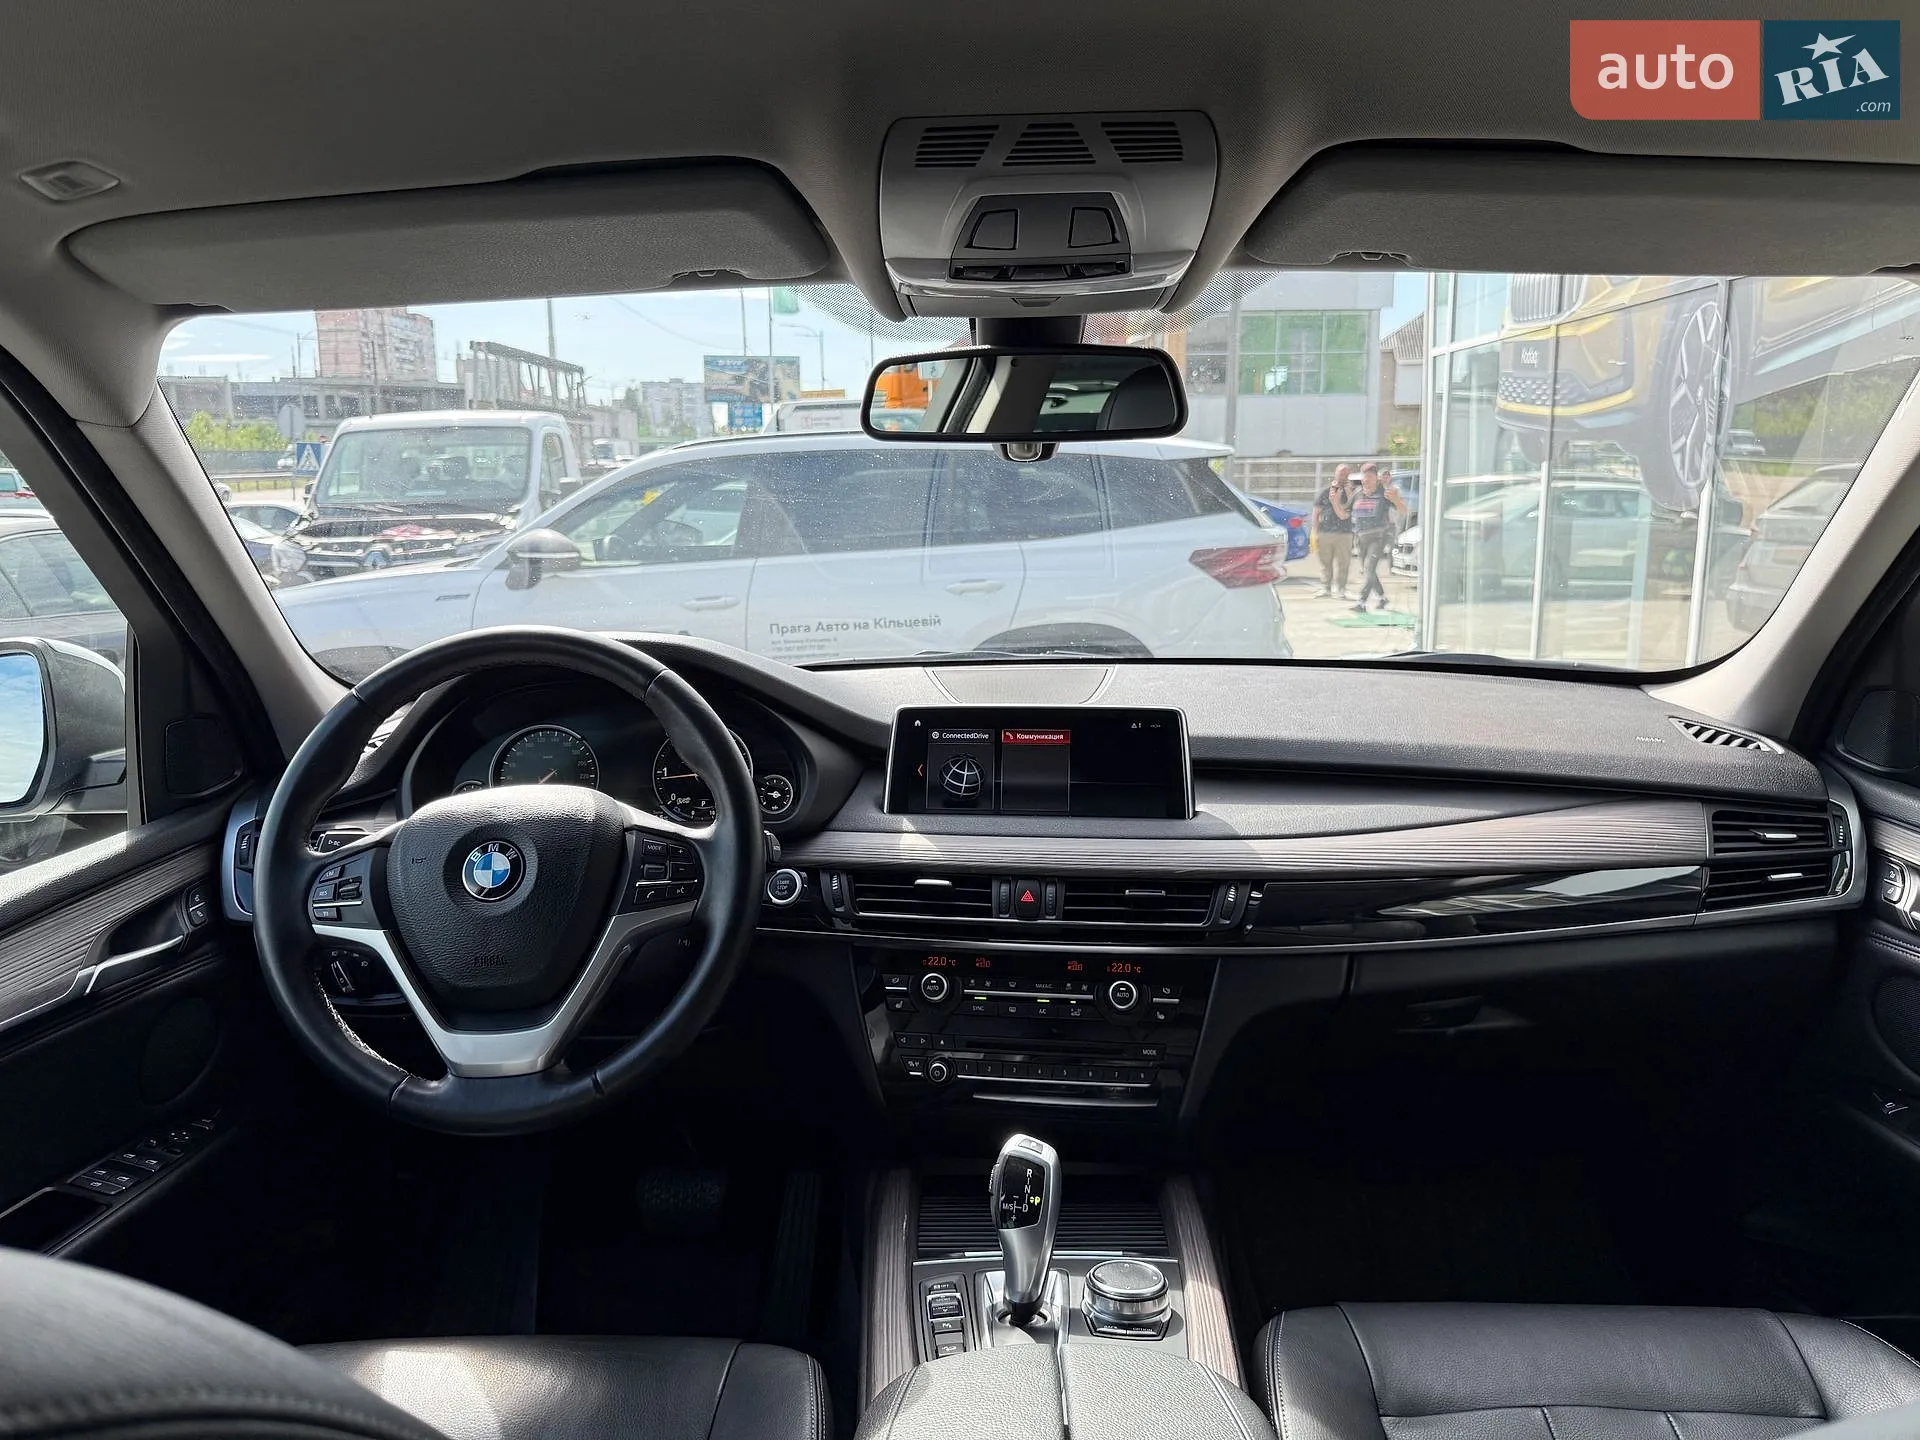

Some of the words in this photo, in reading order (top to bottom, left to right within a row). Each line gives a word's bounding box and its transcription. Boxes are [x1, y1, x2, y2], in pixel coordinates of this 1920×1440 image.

[769, 623, 811, 637] Прага
[815, 621, 850, 634] Авто
[853, 621, 869, 631] на
[873, 614, 942, 630] Кільцевій
[942, 732, 989, 740] ConnectedDrive
[1016, 733, 1064, 741] Коммуникация
[470, 843, 518, 862] BMW
[927, 956, 947, 966] 22.0
[1111, 963, 1131, 973] 22.0
[1026, 1168, 1033, 1178] R
[1024, 1184, 1031, 1194] N
[1034, 1195, 1041, 1206] P
[1022, 1203, 1029, 1213] D
